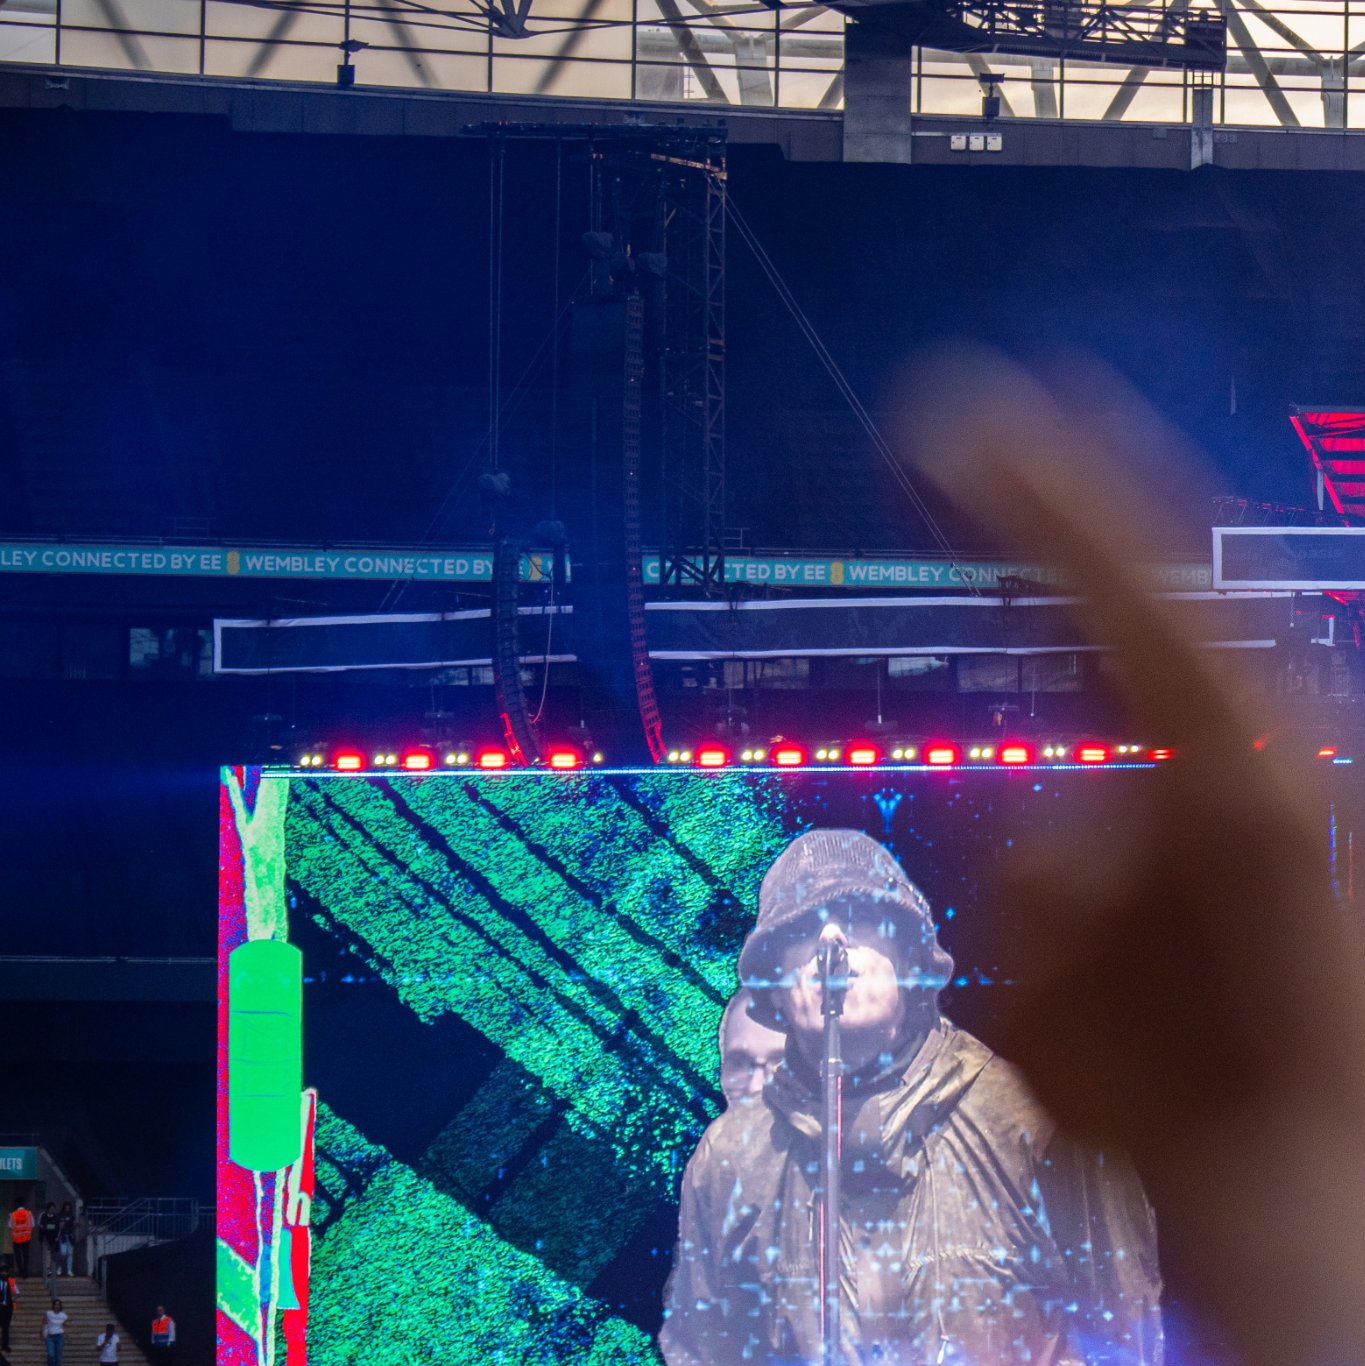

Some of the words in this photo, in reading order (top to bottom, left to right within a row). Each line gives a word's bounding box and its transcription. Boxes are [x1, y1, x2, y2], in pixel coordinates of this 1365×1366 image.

[42, 551, 166, 569] CONNECTED
[171, 554, 196, 570] BY
[200, 555, 222, 571] EE
[246, 556, 341, 573] WEMBLEY
[344, 557, 469, 575] CONNECTED
[775, 564, 800, 581] BY
[804, 565, 826, 581] EE
[849, 565, 944, 582] WEMBLEY
